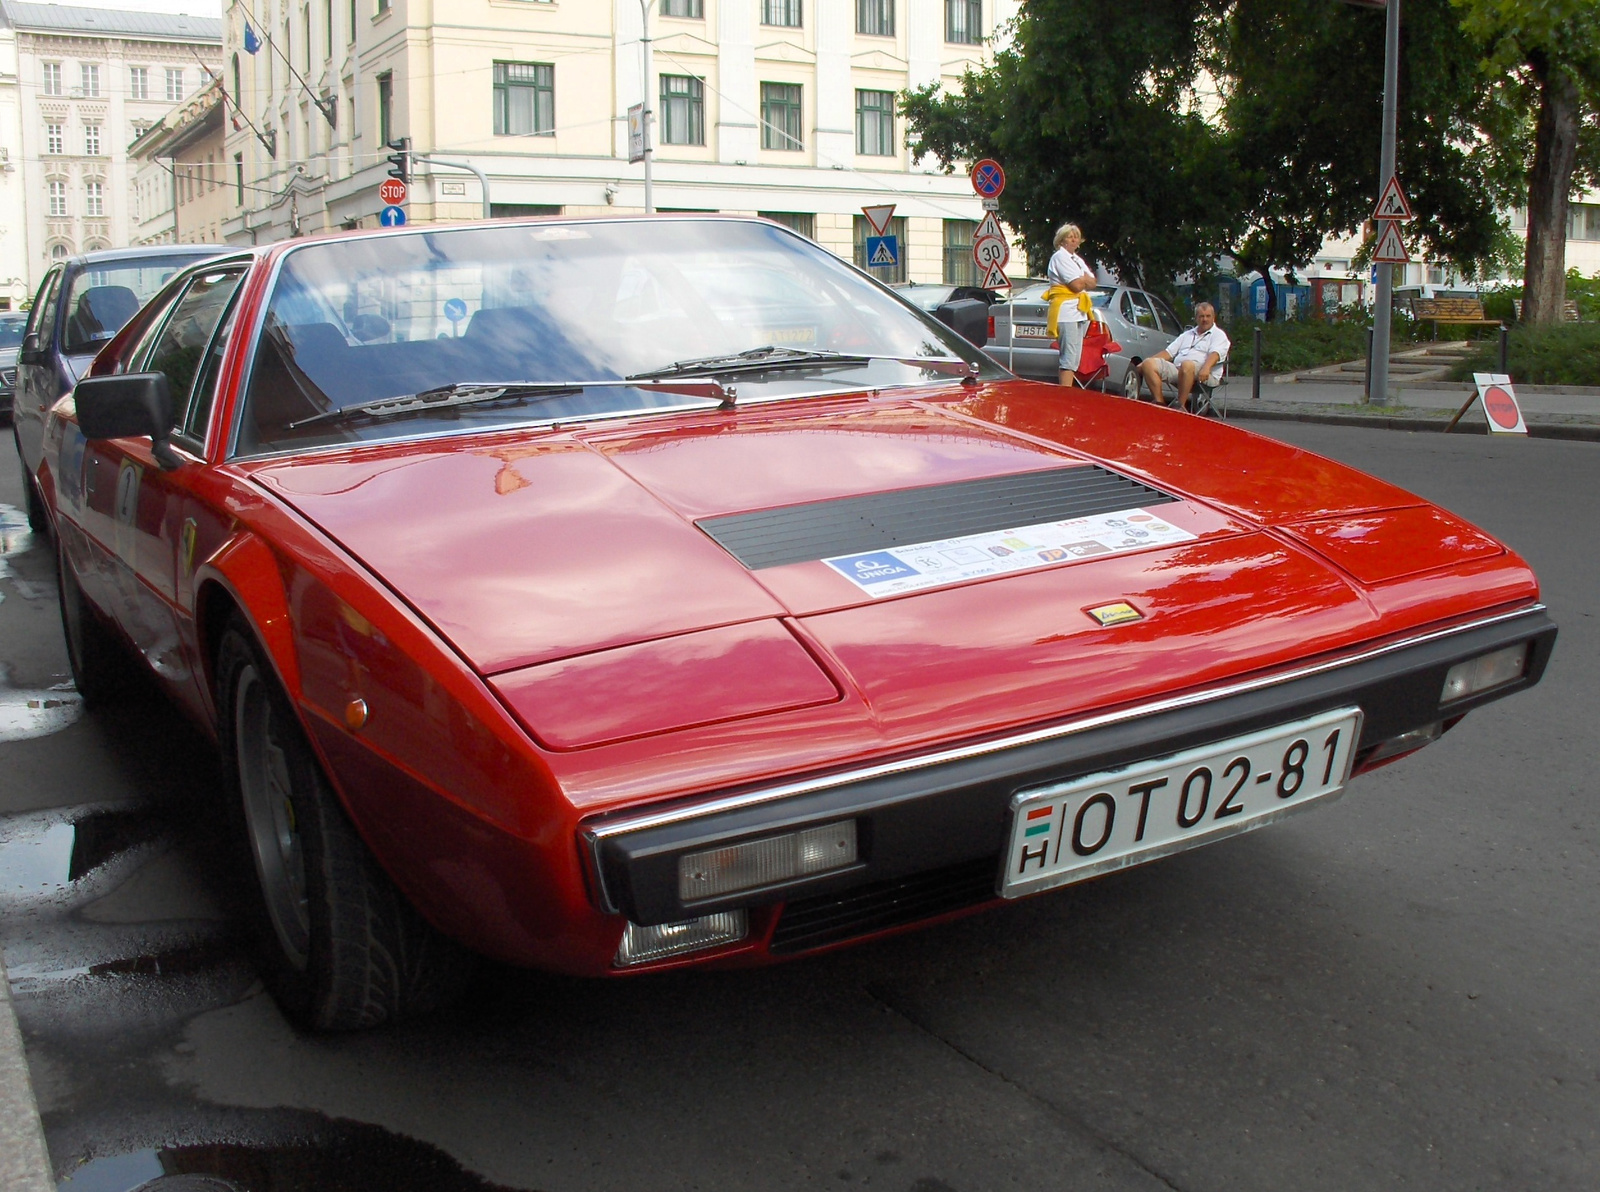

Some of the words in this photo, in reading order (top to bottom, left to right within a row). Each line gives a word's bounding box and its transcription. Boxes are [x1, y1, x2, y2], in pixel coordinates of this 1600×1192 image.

[381, 186, 405, 198] STOP
[982, 244, 1001, 262] 30
[1018, 839, 1049, 873] H
